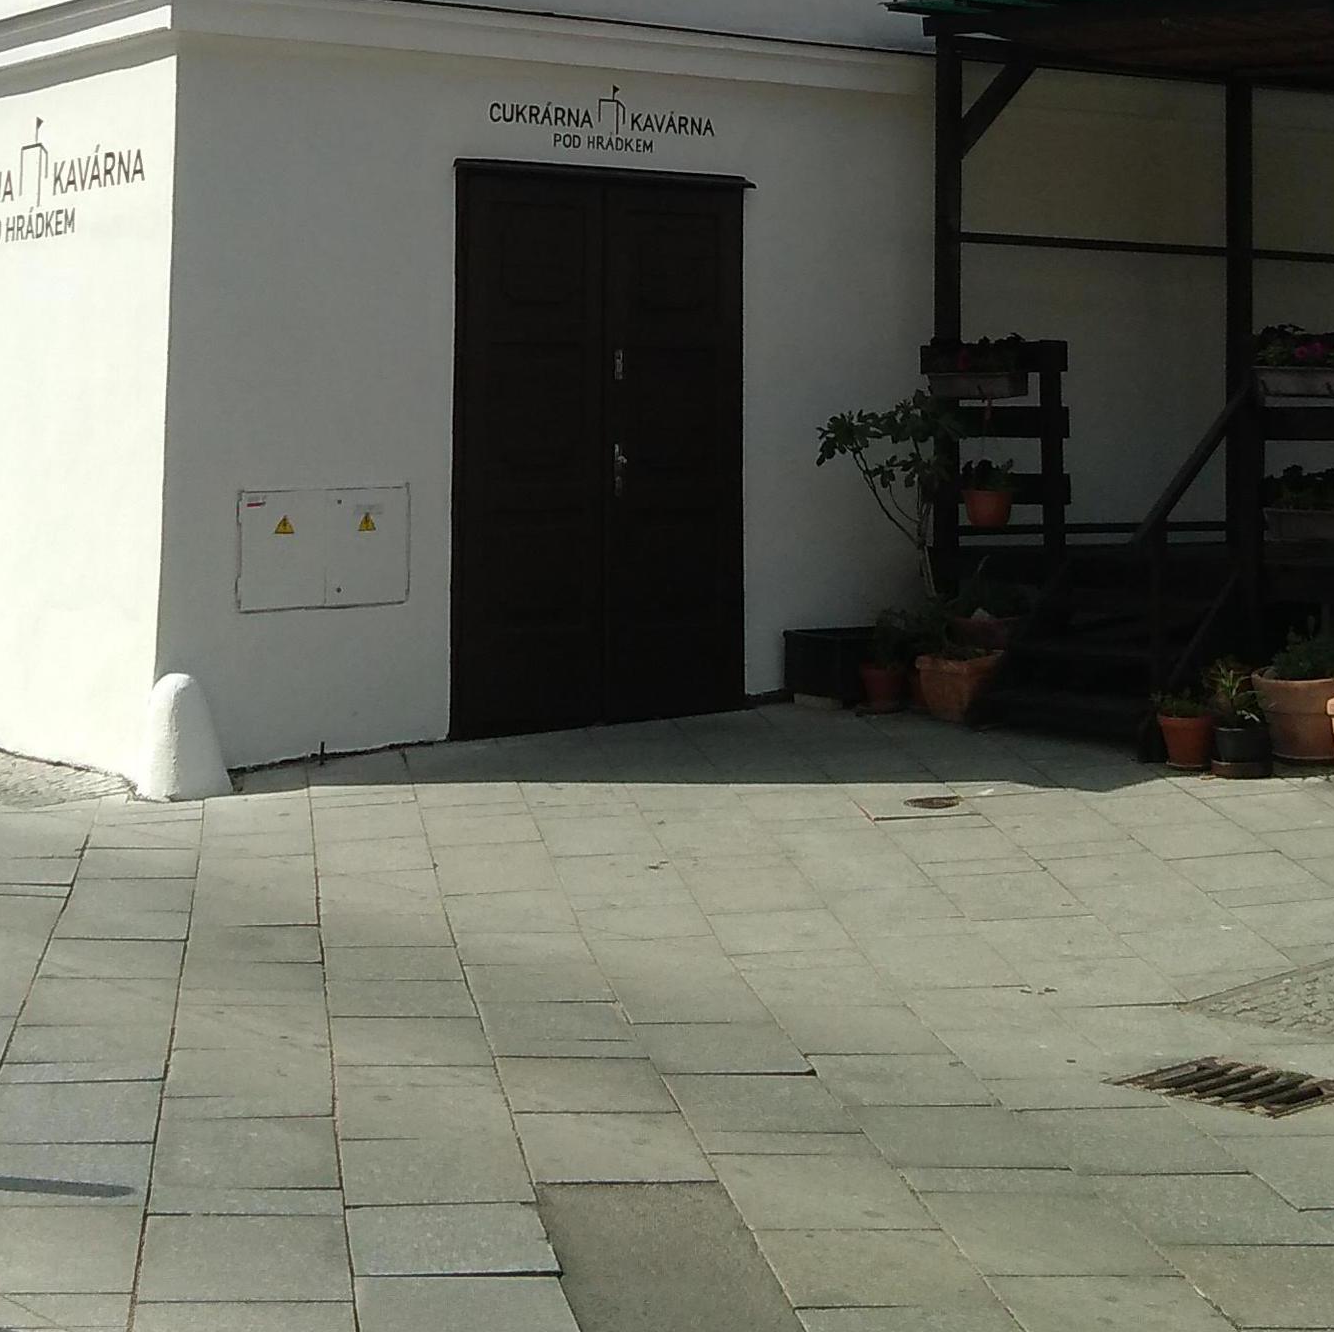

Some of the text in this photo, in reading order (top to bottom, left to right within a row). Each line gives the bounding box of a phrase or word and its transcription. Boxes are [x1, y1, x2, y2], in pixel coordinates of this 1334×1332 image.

[489, 101, 716, 138] CUKRÁRNA KAVÁRNA
[553, 131, 655, 154] POD HRÁDKEM
[52, 143, 146, 197] KAVÁRNA
[4, 206, 76, 244] HRÁDKEM
